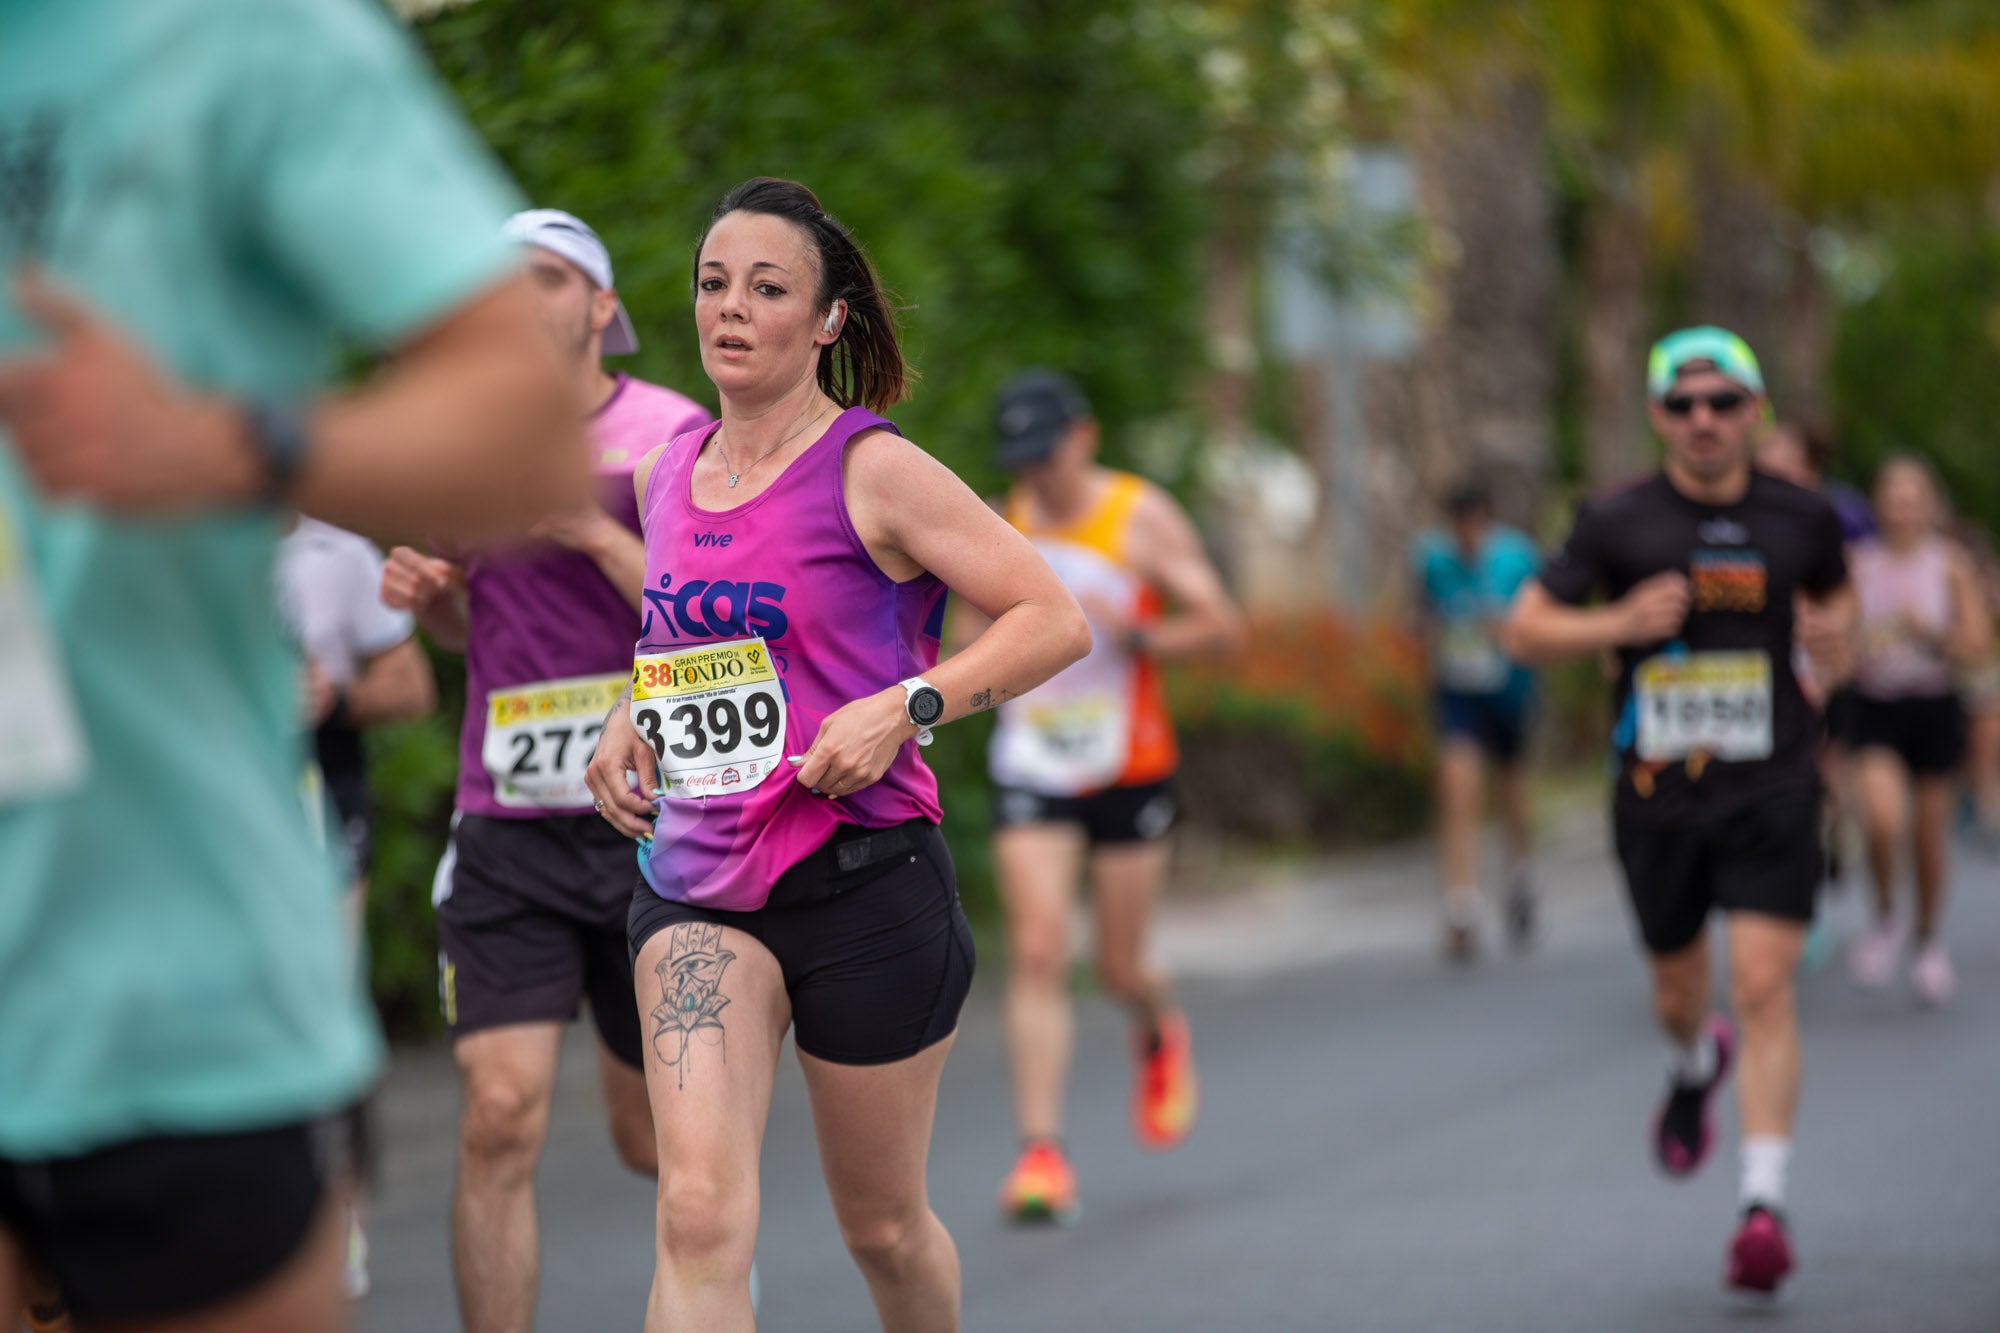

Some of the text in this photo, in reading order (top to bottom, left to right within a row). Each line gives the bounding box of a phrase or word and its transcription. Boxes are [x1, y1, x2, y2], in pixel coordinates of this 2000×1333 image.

[694, 531, 733, 547] vive
[674, 657, 697, 668] GRAN
[698, 651, 733, 663] PREMIO
[643, 663, 672, 688] 38
[672, 658, 744, 687] FONDO
[637, 691, 780, 761] 3399
